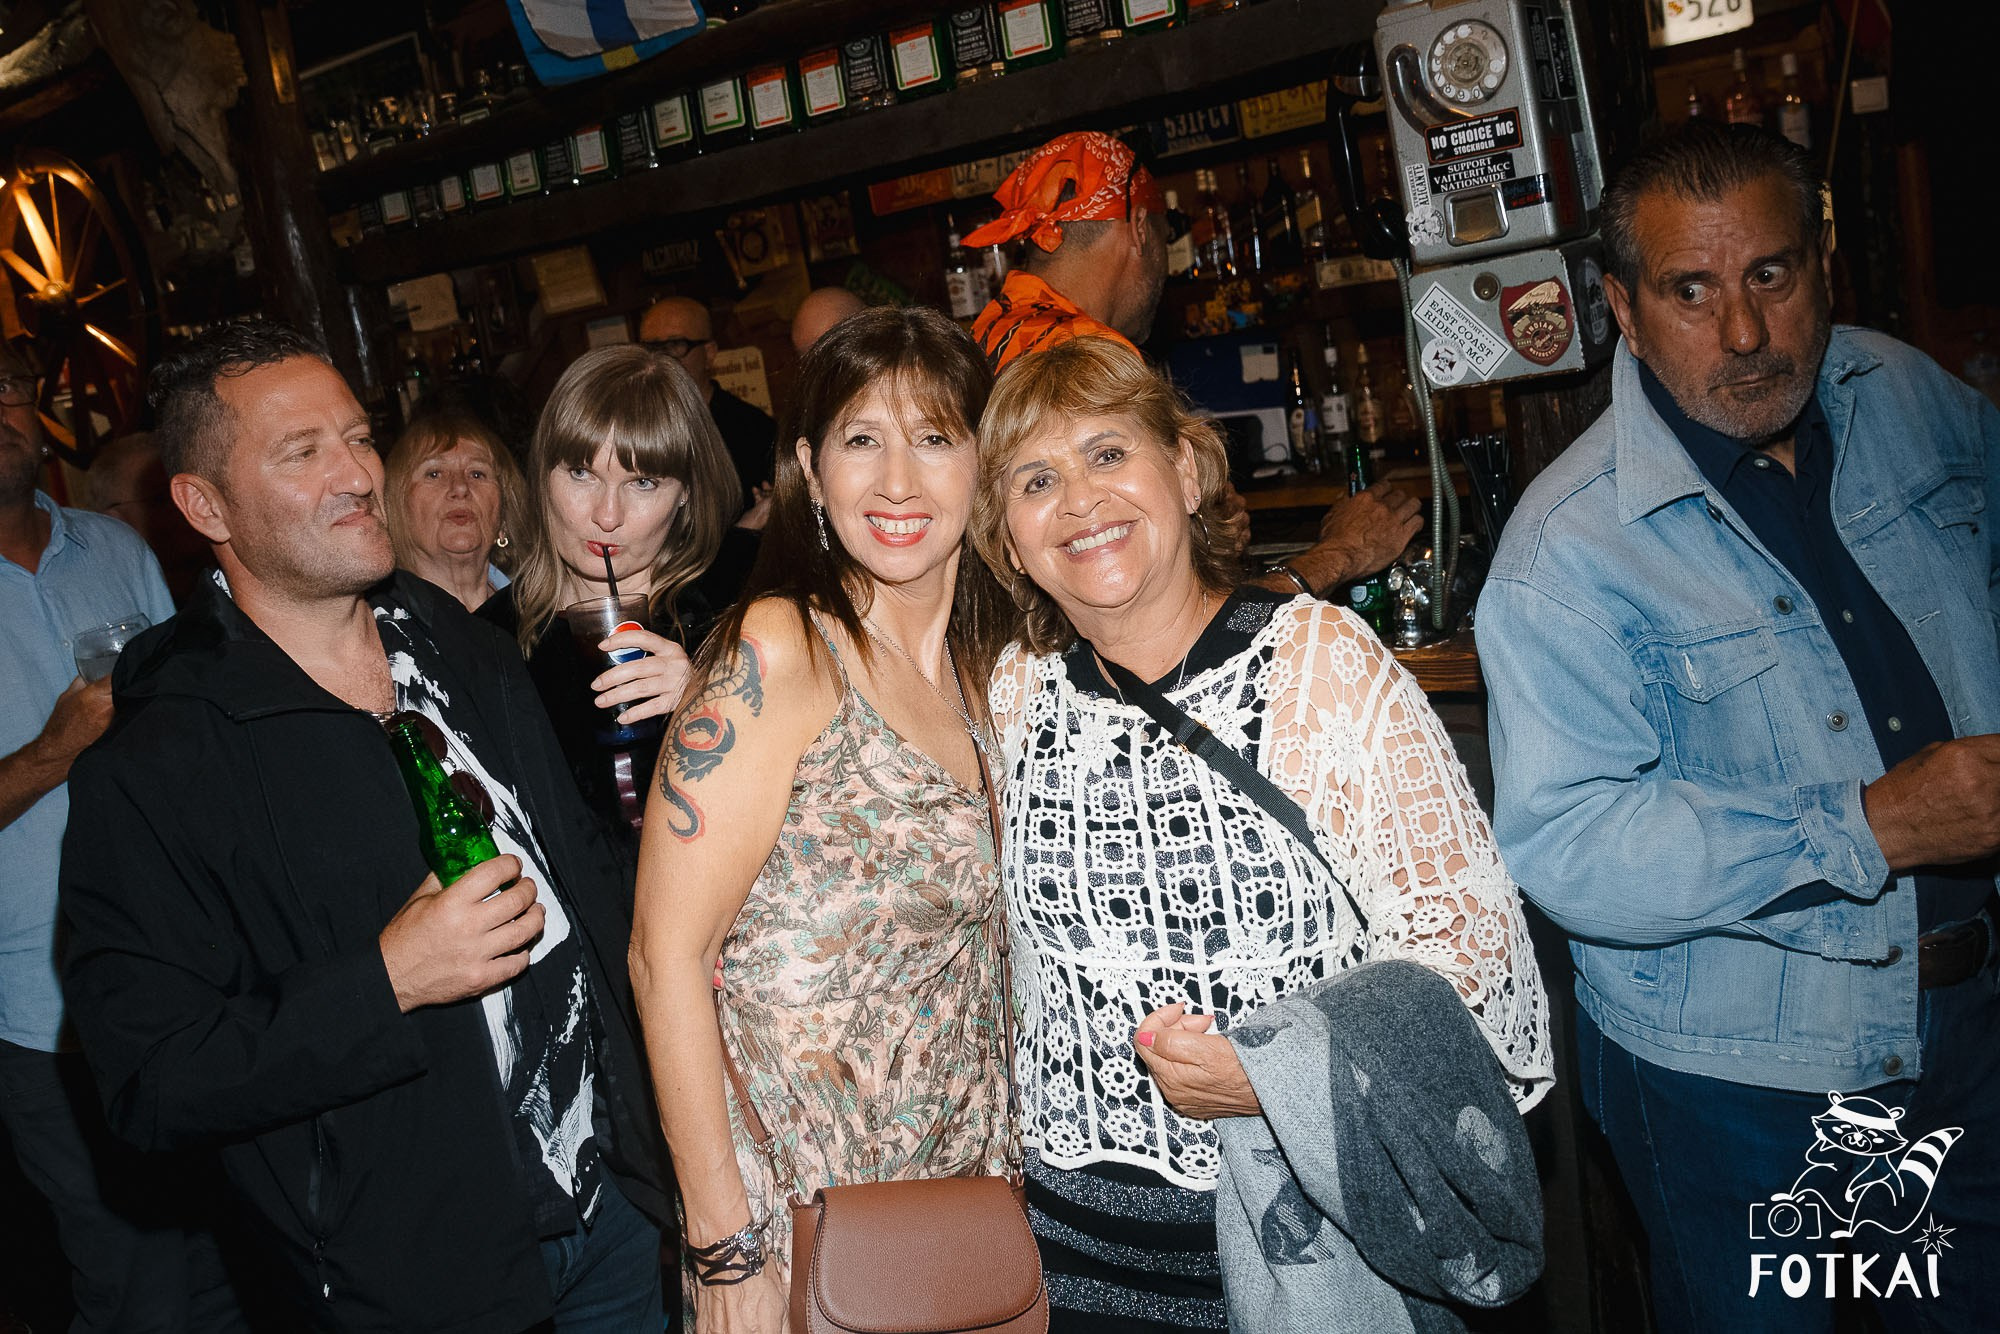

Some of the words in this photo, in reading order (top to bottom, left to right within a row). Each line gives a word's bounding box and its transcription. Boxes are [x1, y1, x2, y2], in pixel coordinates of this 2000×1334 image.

[1430, 134, 1447, 150] NO
[1450, 125, 1493, 146] CHOICE
[1496, 120, 1514, 137] MC
[1453, 139, 1495, 155] STOCKHOLM
[1447, 157, 1492, 173] SUPPORT
[1487, 161, 1511, 173] MCC
[1413, 164, 1429, 206] ALICANTE
[1440, 172, 1506, 193] NATIONWIDE
[1429, 300, 1458, 326] EAST
[1457, 325, 1494, 358] COAST
[1454, 309, 1482, 335] SUPPORT
[1526, 321, 1554, 335] INDIAN
[1424, 310, 1466, 347] RIDERS
[1466, 347, 1484, 365] MC
